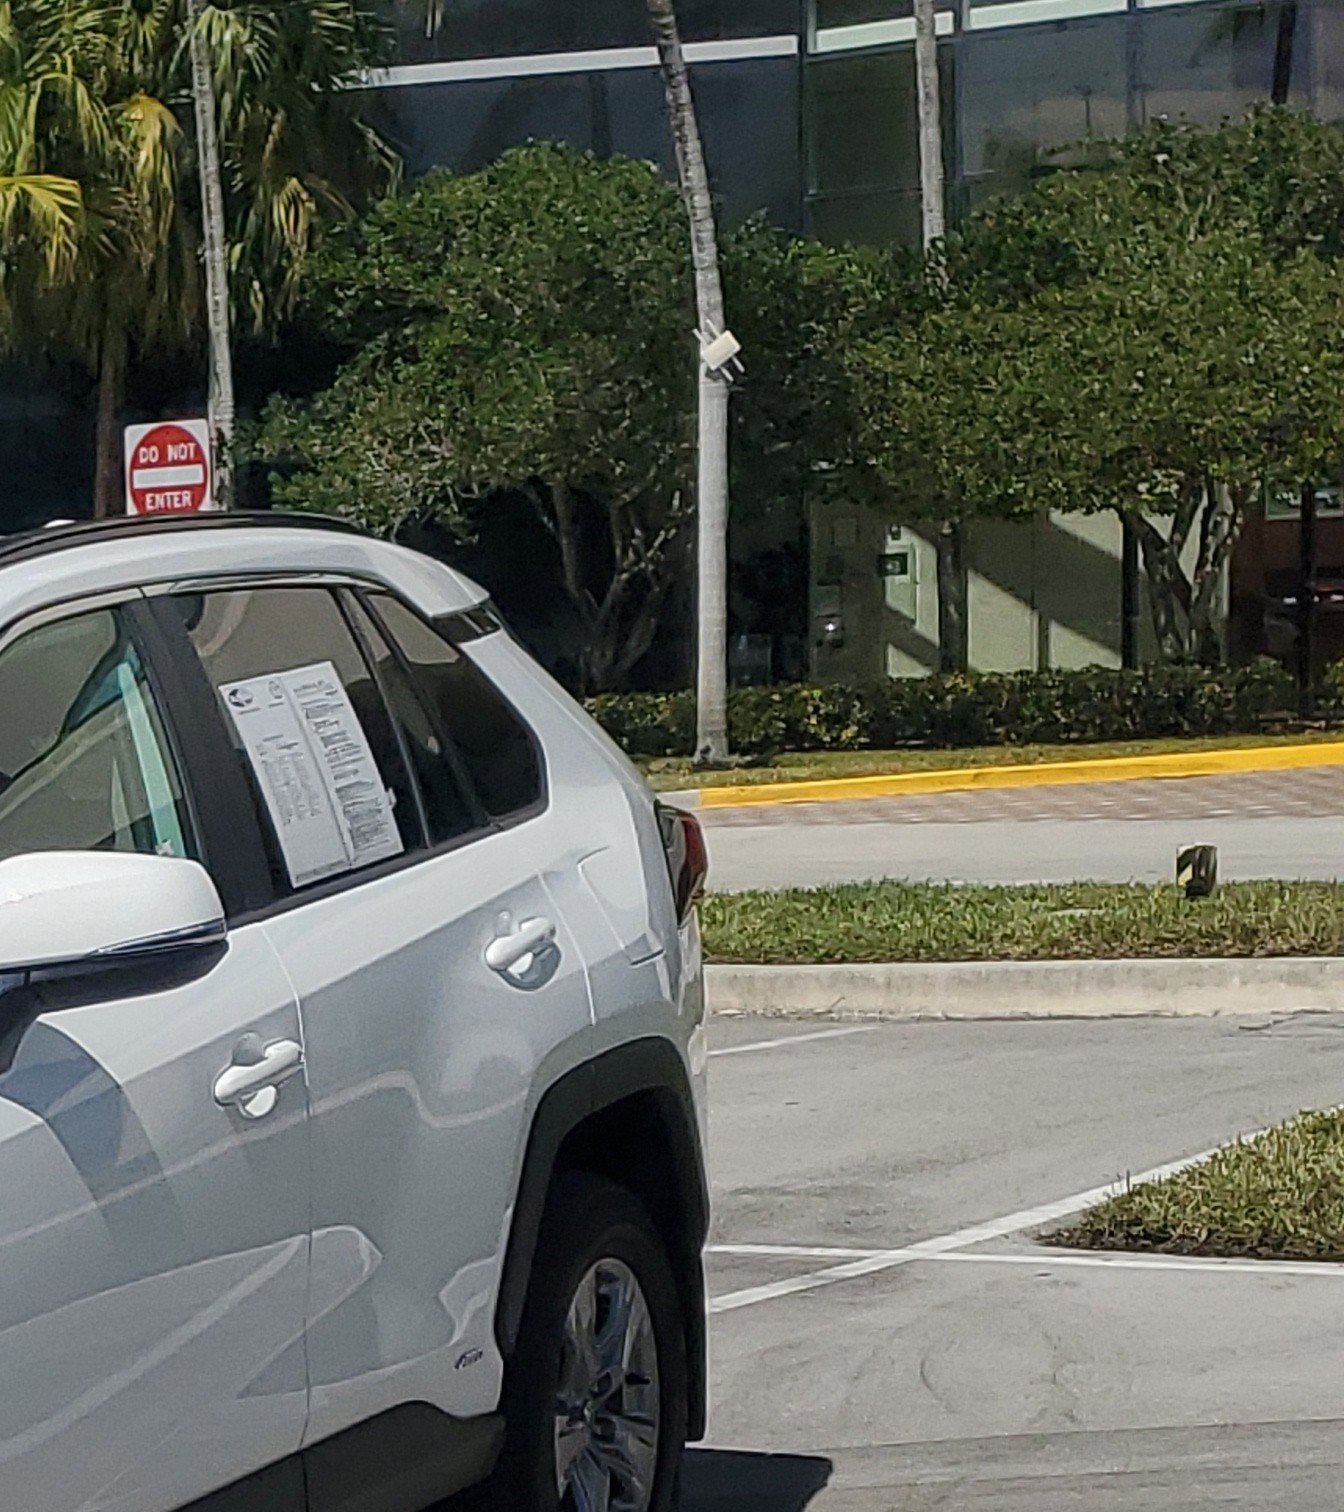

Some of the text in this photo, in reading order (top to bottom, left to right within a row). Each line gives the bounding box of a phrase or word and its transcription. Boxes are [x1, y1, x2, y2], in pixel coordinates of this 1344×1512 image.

[139, 443, 197, 464] DO NOT
[145, 490, 192, 511] ENTER
